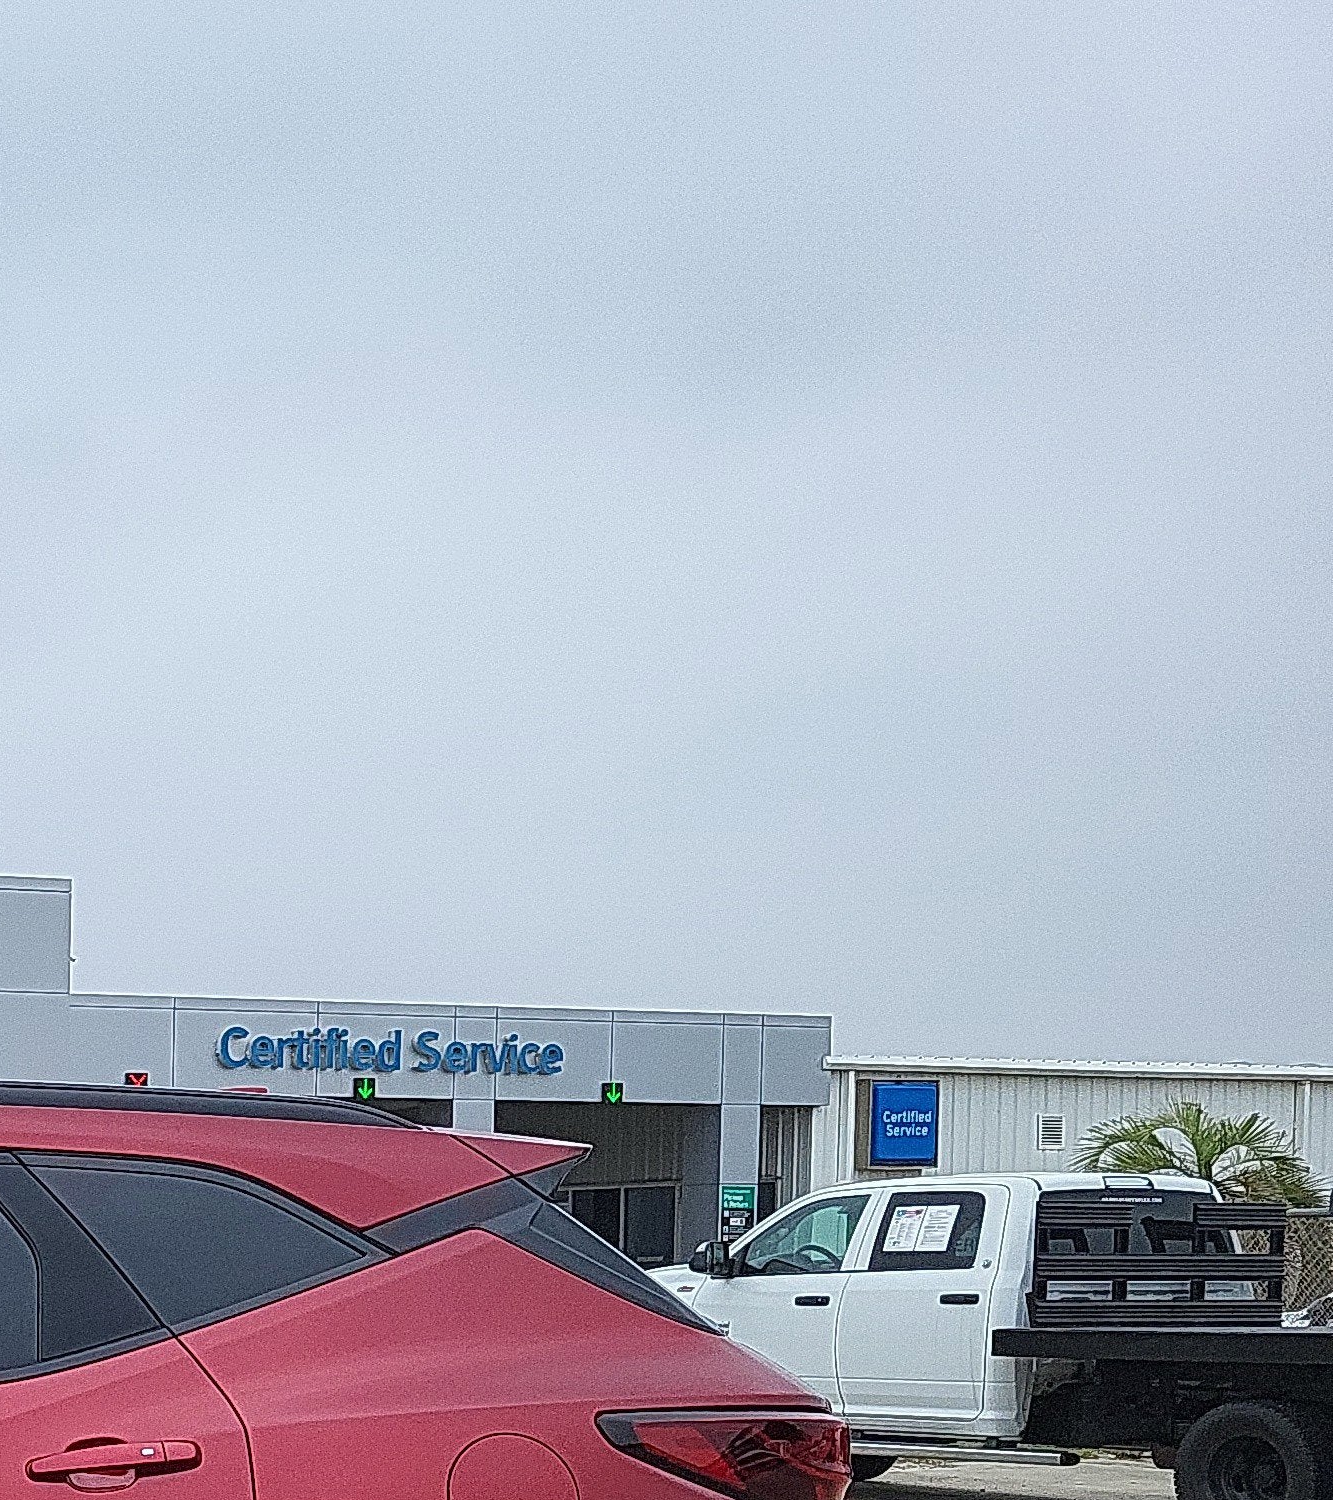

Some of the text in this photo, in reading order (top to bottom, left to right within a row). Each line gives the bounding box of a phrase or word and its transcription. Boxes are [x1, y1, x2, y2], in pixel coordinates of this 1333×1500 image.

[218, 1027, 564, 1074] Certified Service
[882, 1110, 932, 1136] Certified Service
